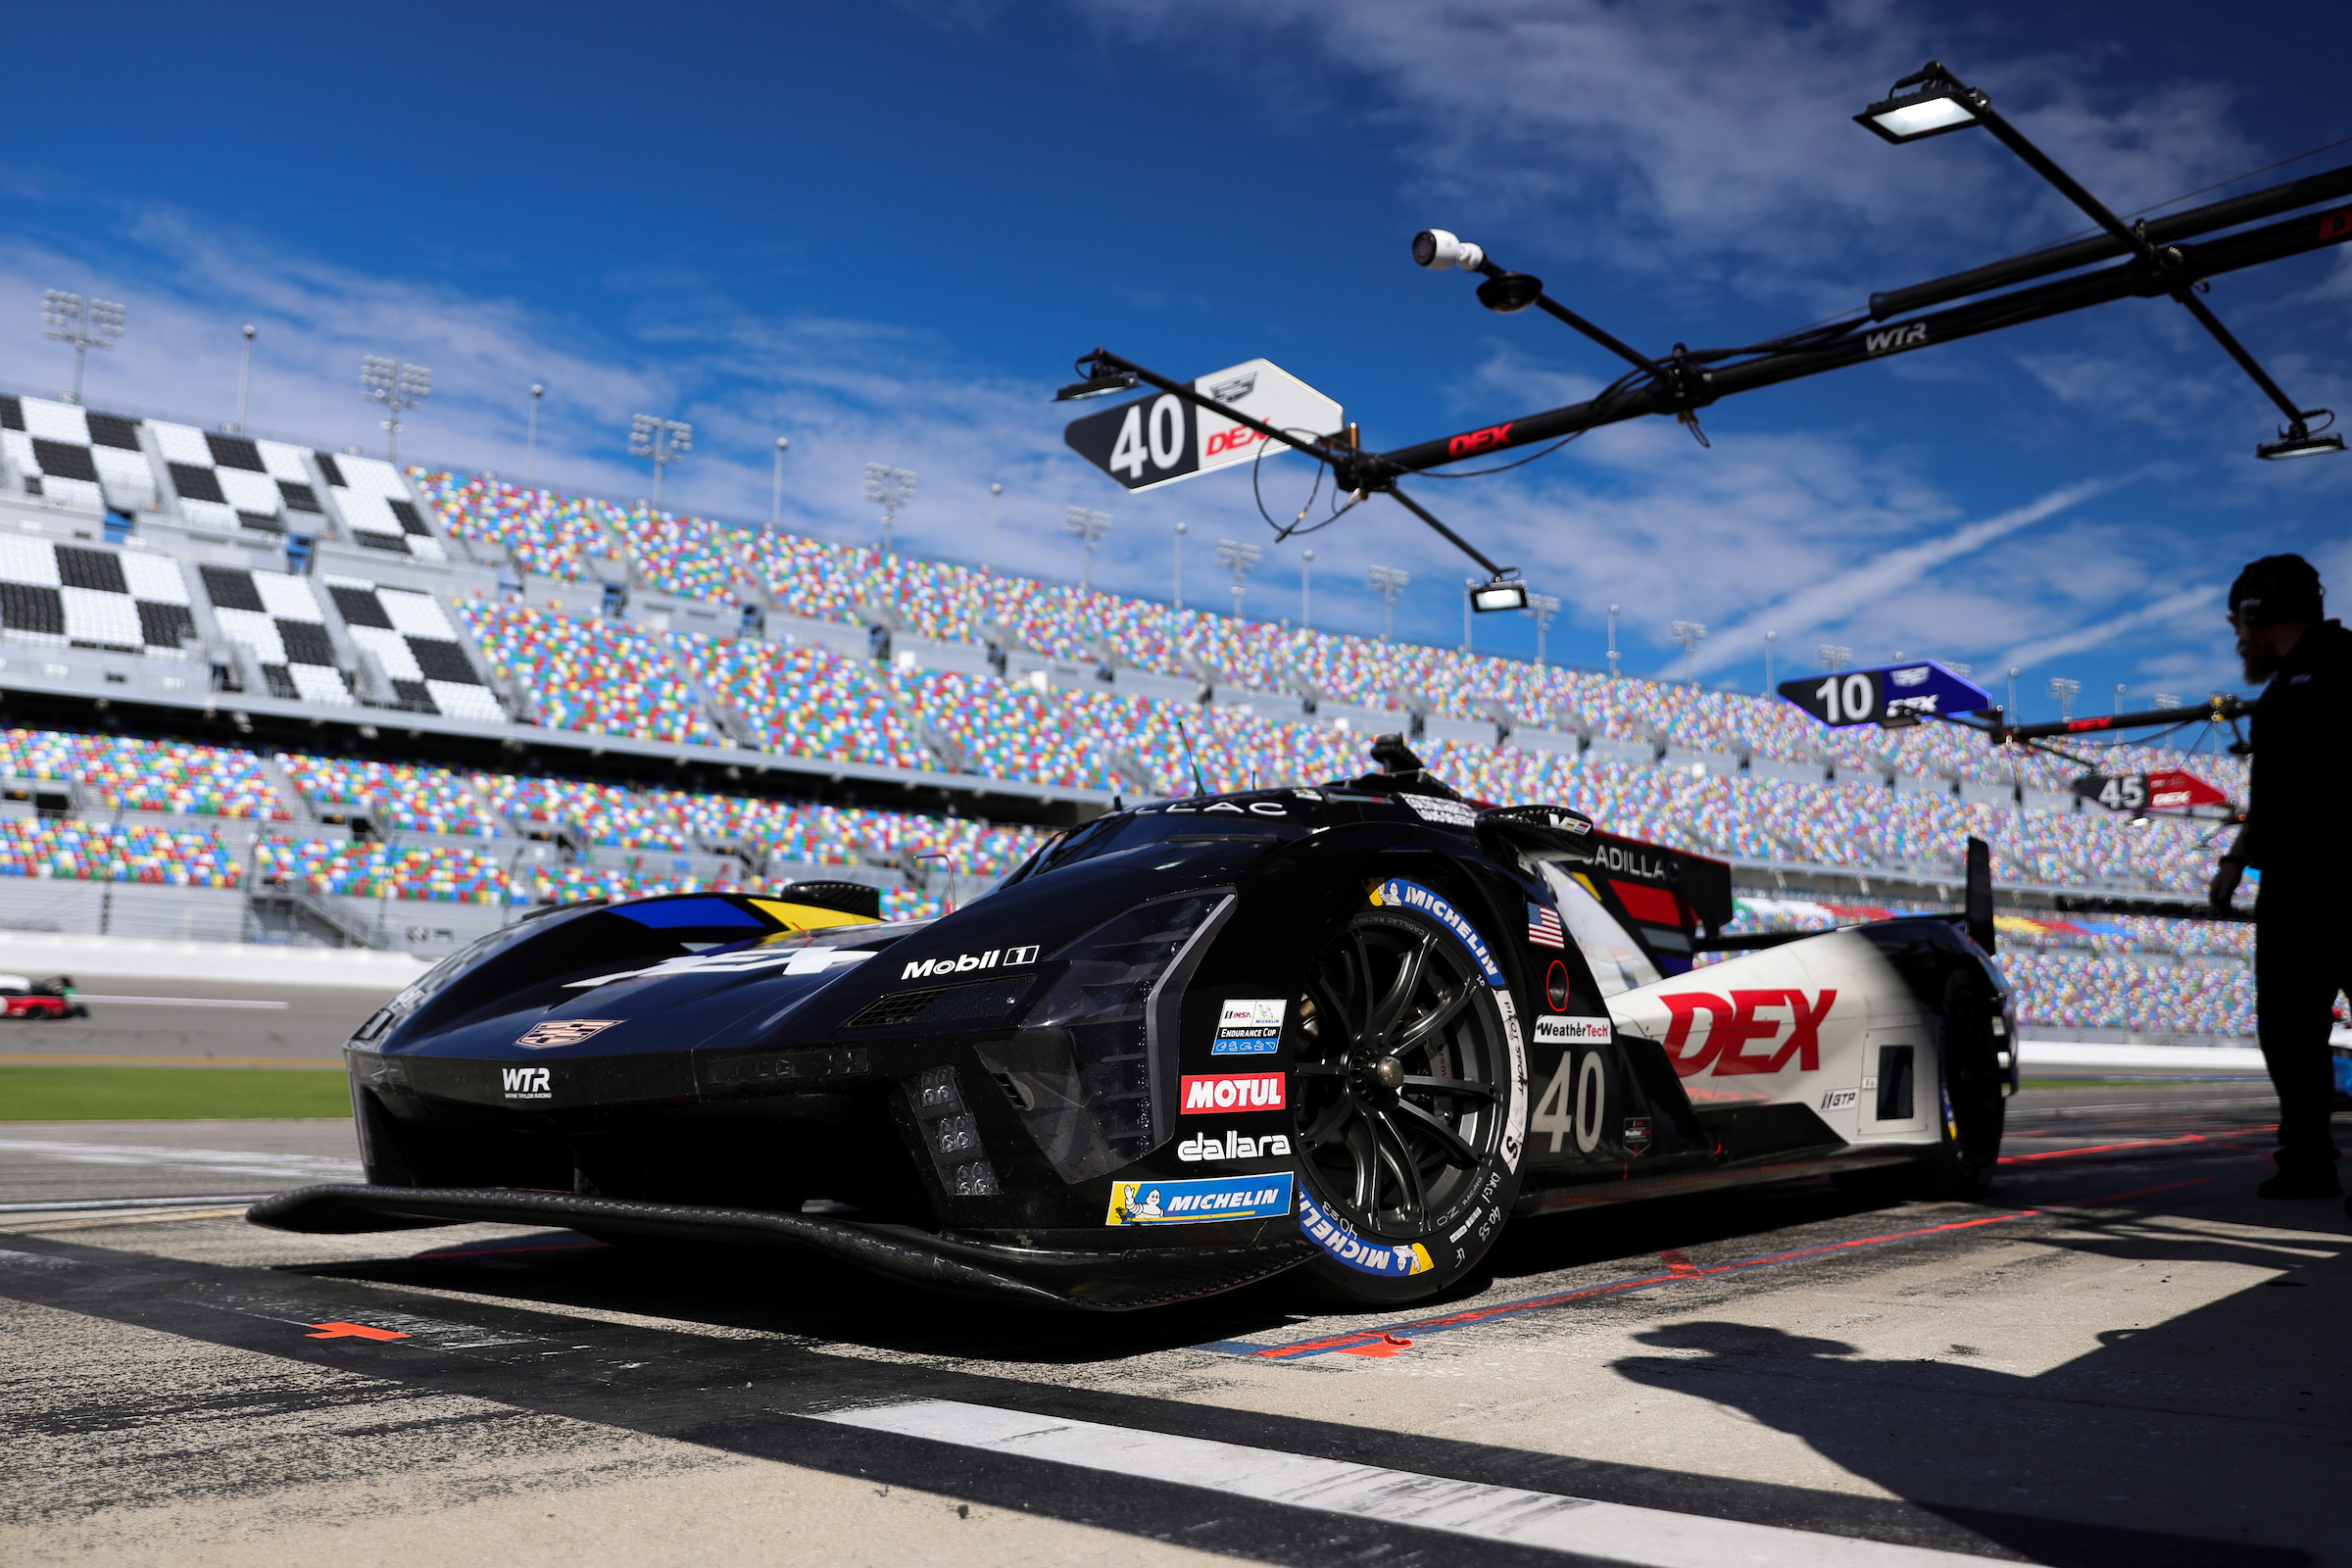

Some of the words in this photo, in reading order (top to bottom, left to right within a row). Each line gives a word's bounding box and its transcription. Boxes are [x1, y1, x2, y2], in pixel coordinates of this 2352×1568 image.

[1866, 321, 1928, 352] WTR
[1109, 393, 1186, 479] 40
[1205, 416, 1271, 458] DEX
[1448, 422, 1514, 459] DEX
[1816, 673, 1874, 723] 10
[2098, 776, 2145, 809] 45
[1387, 916, 1425, 936] CADILLAC
[1404, 886, 1498, 976] MICHELIN
[901, 950, 1001, 980] Mobil
[1221, 1029, 1262, 1038] ENDURANCE
[1537, 1021, 1608, 1038] WeatherTech
[1658, 988, 1838, 1078] DEX
[1503, 1002, 1519, 1041] PILOT
[1514, 1046, 1526, 1097] SPORT
[502, 1067, 551, 1093] WTR
[1186, 1078, 1282, 1109] MOTUL
[1531, 1051, 1605, 1153] 40
[1833, 1092, 1856, 1106] GTP
[1177, 1130, 1292, 1162] dallara
[1166, 1189, 1279, 1212] MICHELIN
[1462, 1177, 1483, 1205] RACING
